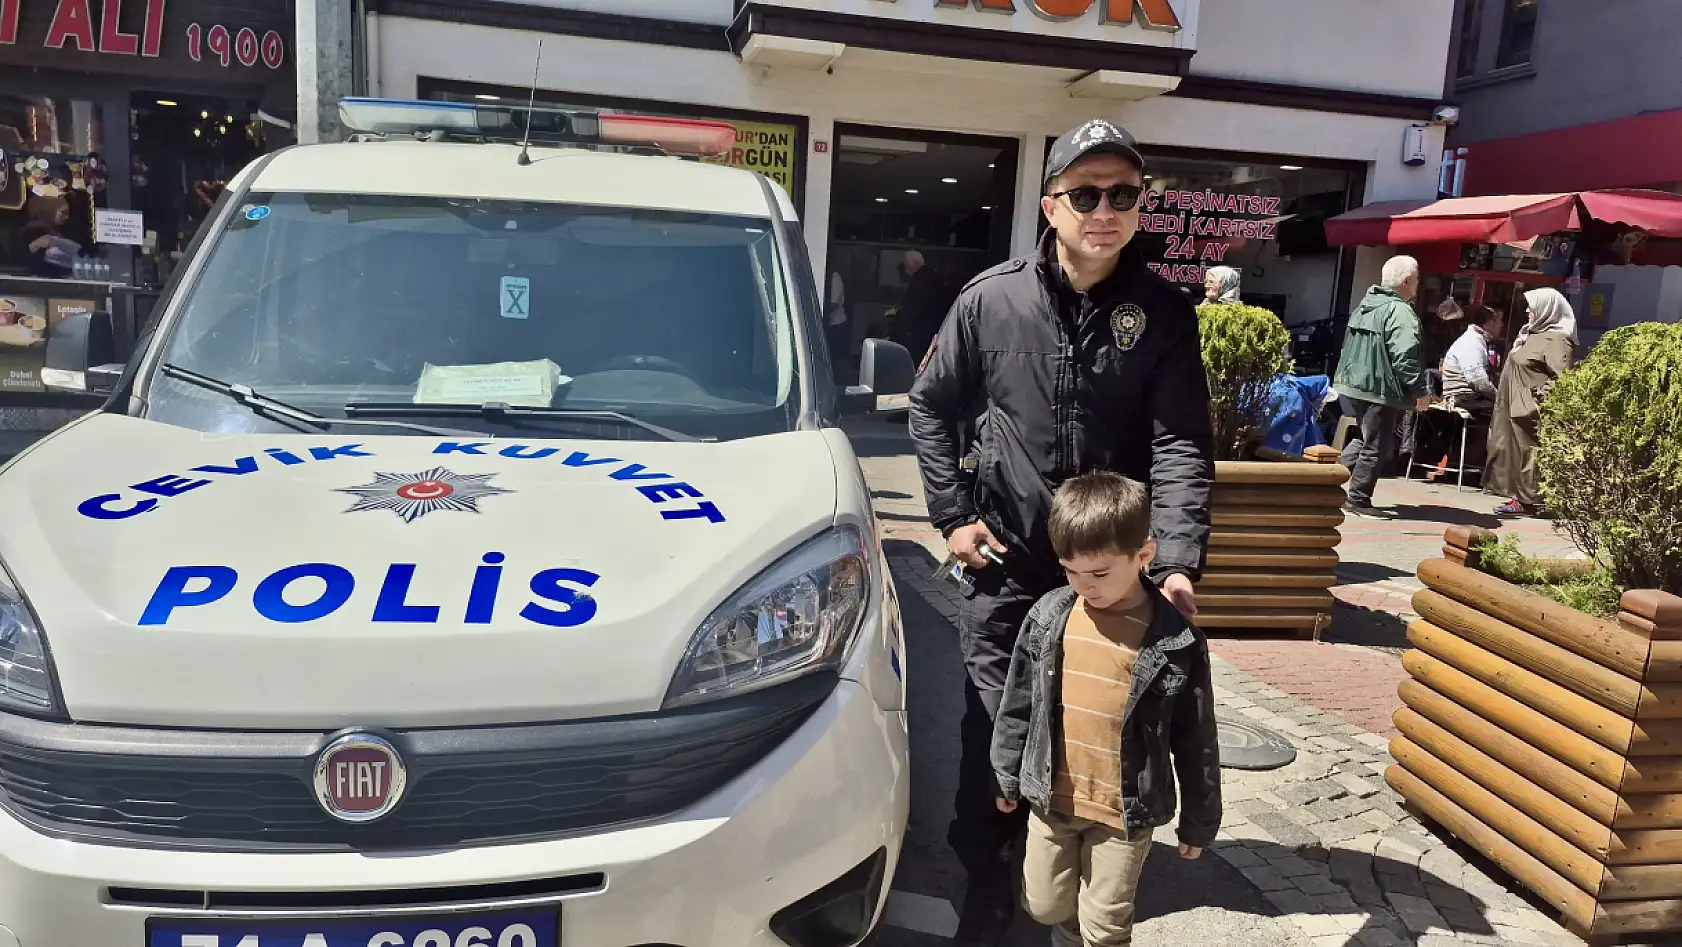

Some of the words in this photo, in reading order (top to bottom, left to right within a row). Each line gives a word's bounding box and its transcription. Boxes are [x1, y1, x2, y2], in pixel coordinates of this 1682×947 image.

[186, 22, 283, 69] 1900
[735, 131, 788, 146] UR'DAN
[1164, 188, 1280, 216] PEŞİNATSIZ
[1137, 211, 1186, 233] REDİ
[1189, 216, 1276, 239] KARTSIZ
[1164, 235, 1195, 259] 24
[1201, 242, 1230, 262] AY
[1147, 261, 1242, 284] TAKSİ
[506, 289, 526, 313] X
[77, 443, 377, 520] ÇEVİK
[432, 441, 726, 523] KUVVET
[137, 551, 601, 628] POLİS
[336, 761, 386, 798] FIAT
